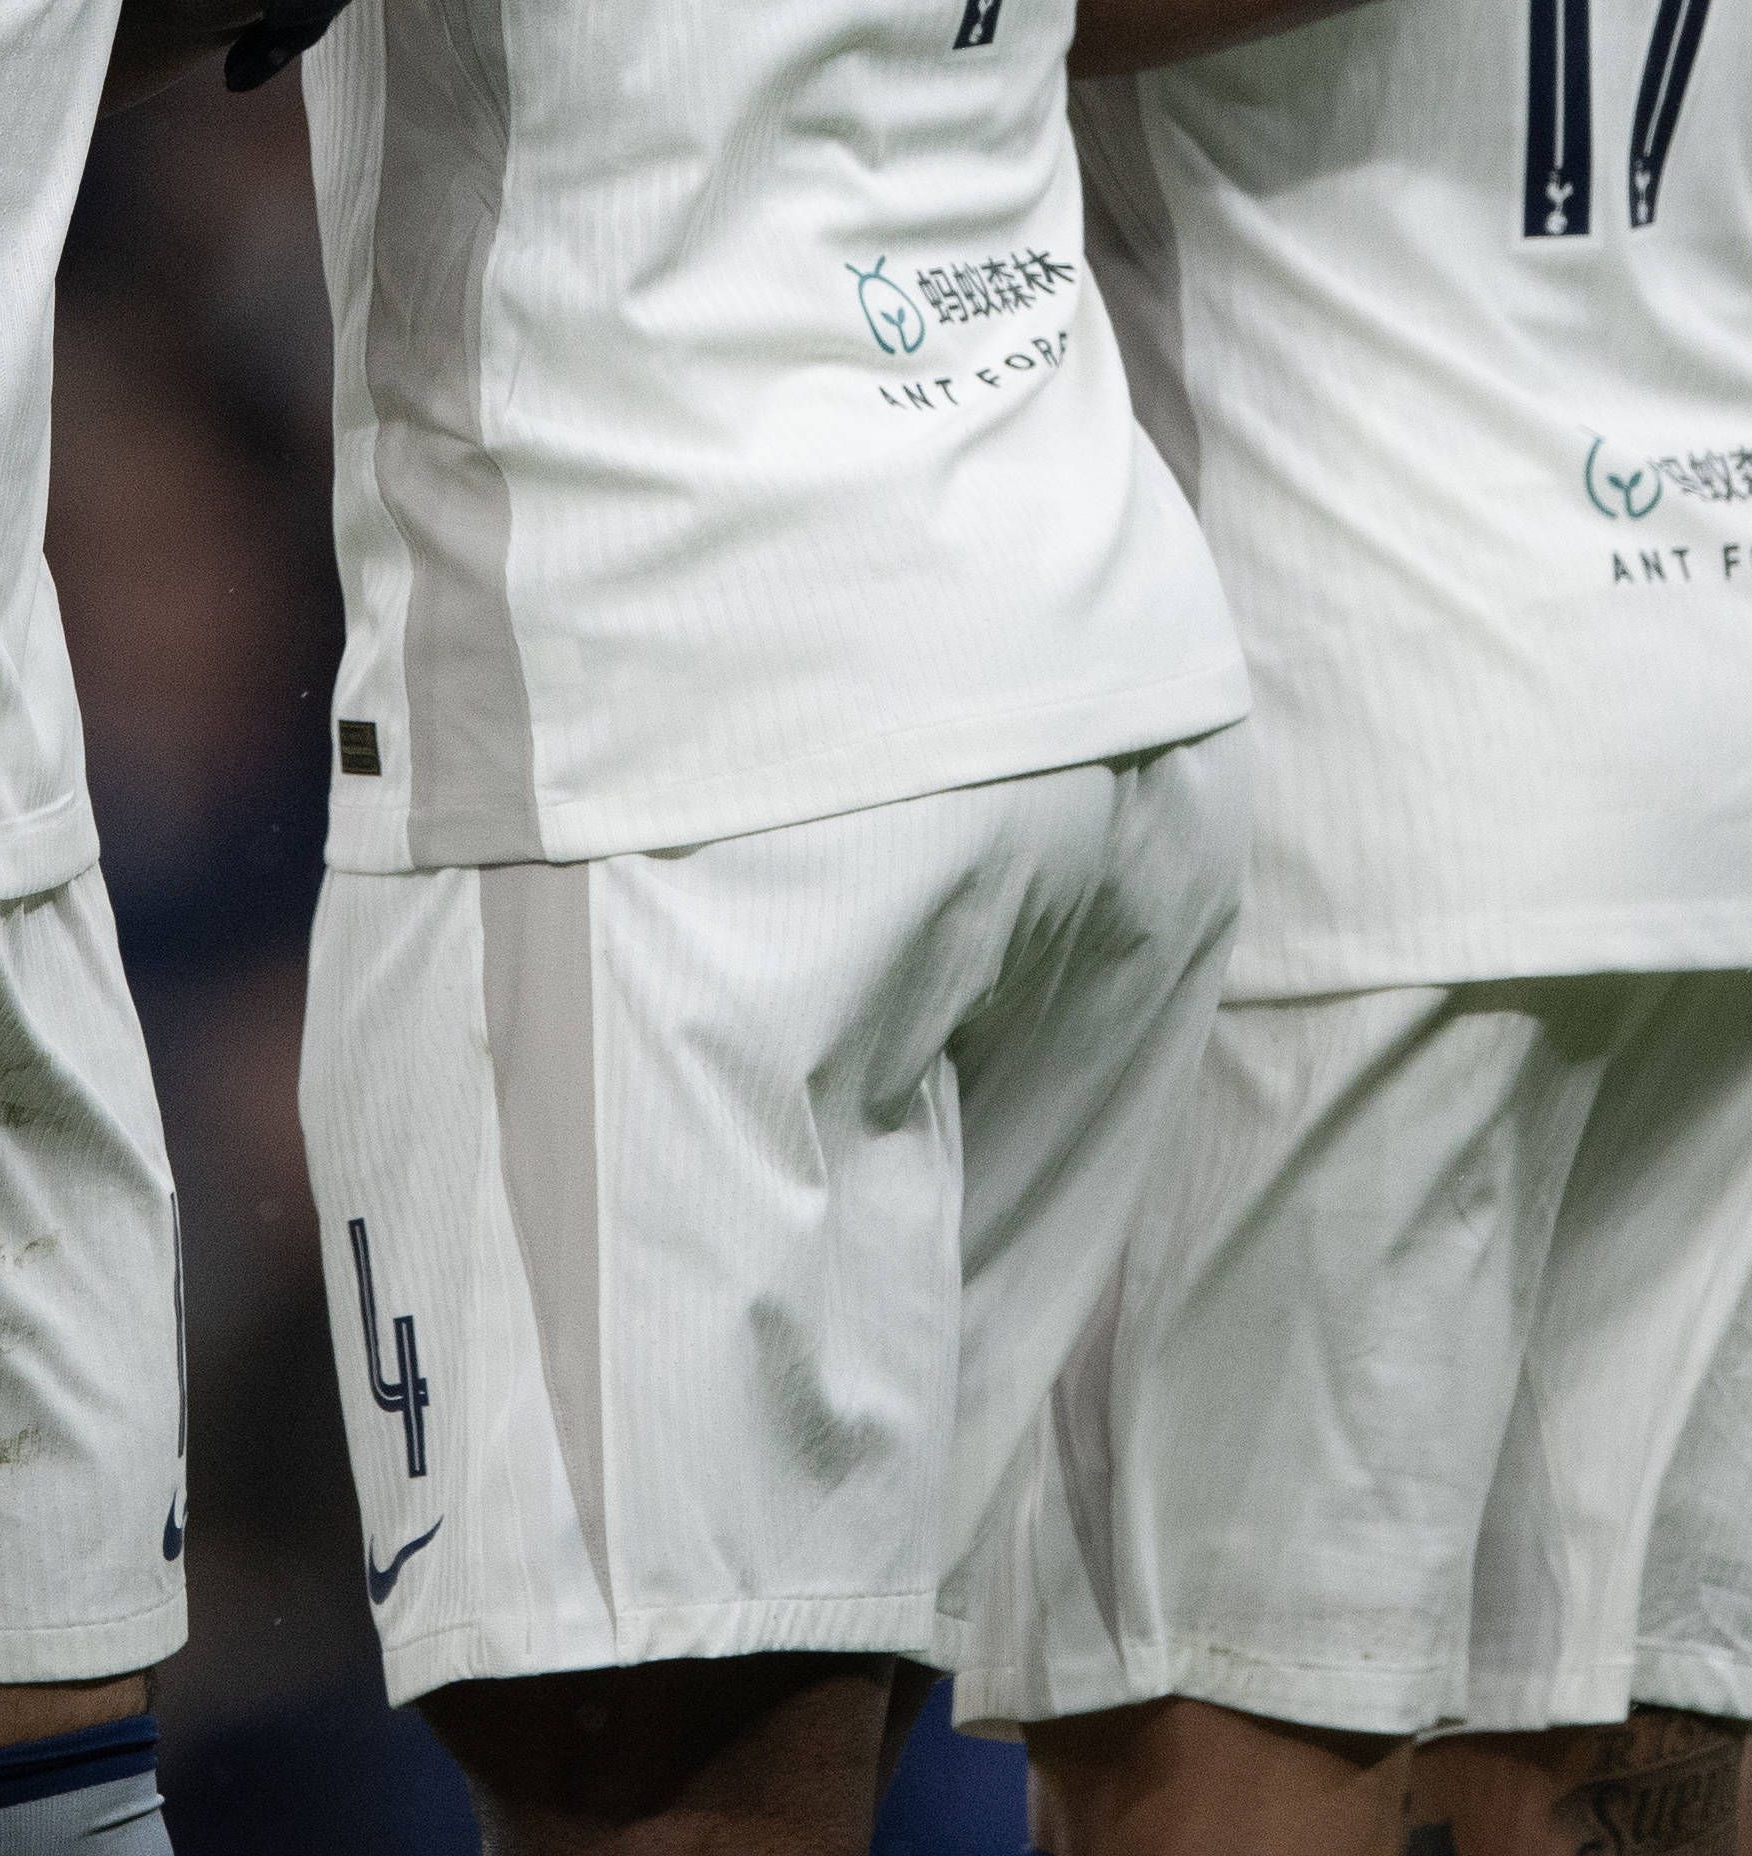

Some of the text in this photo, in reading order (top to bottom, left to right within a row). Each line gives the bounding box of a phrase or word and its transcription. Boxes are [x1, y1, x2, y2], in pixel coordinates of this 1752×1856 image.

[916, 246, 1075, 325] 蚂蚁森林
[1612, 546, 1691, 584] ANT
[348, 1217, 430, 1479] 4
